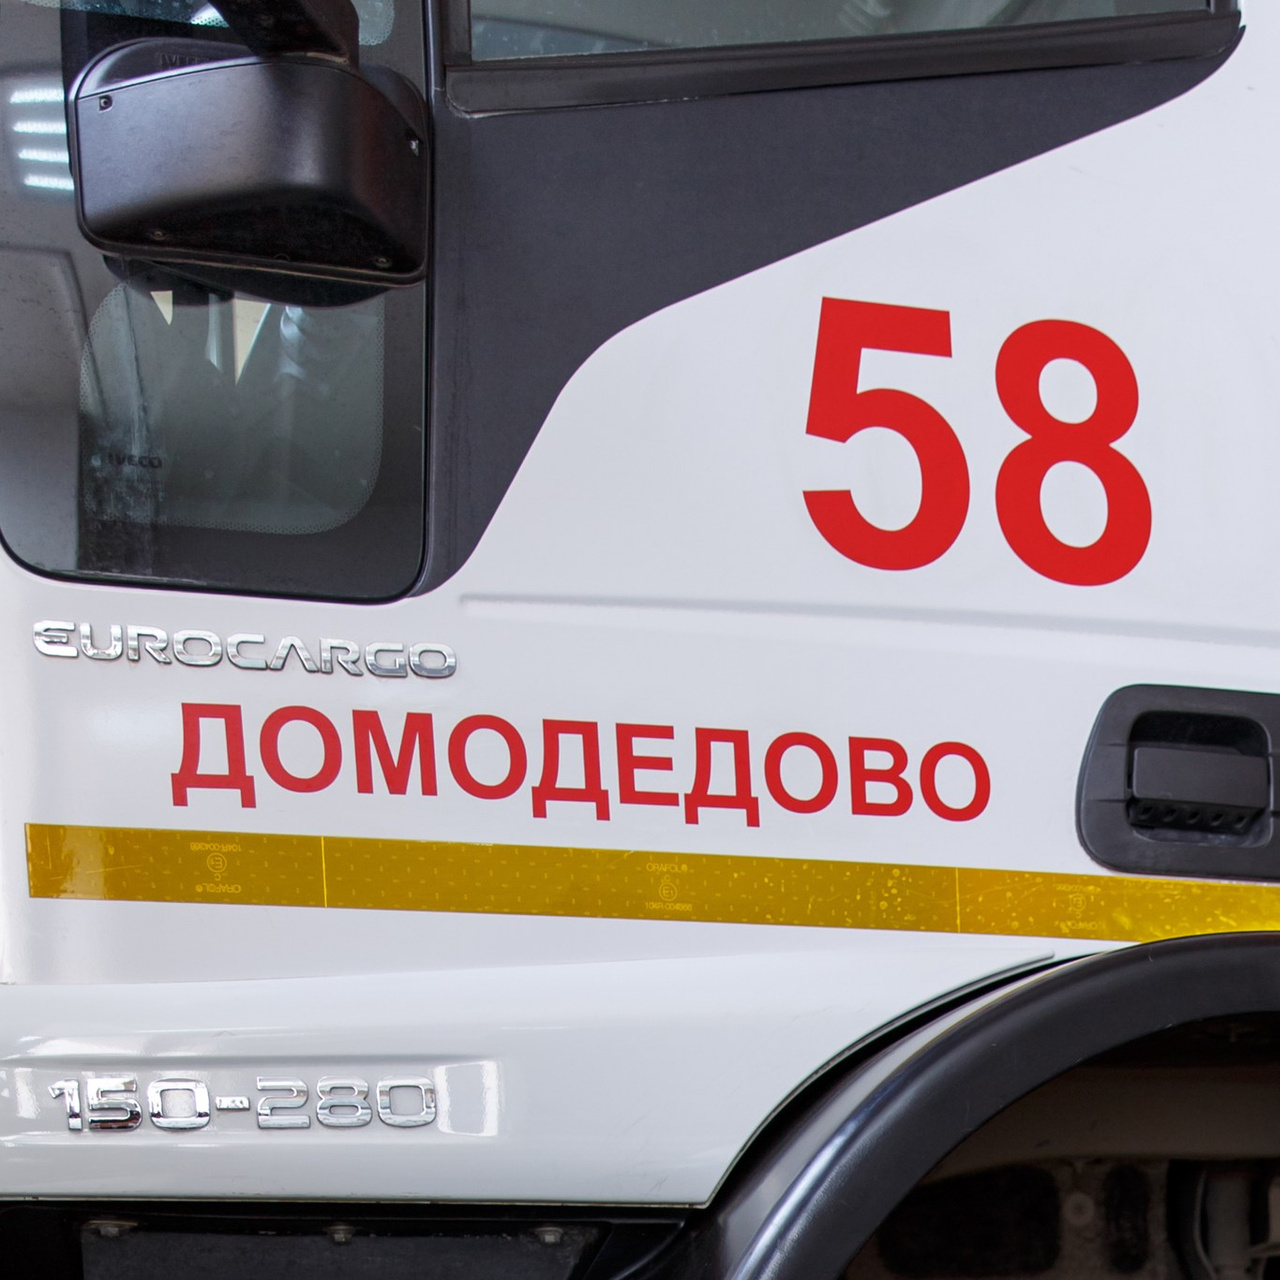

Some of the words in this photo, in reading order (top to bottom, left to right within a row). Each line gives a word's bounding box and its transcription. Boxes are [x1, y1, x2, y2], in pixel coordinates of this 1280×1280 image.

[803, 297, 1152, 586] 58
[33, 620, 457, 678] EUROCARGO
[172, 703, 990, 827] ДОМОДЕДОВО
[47, 1075, 438, 1131] 150-280
